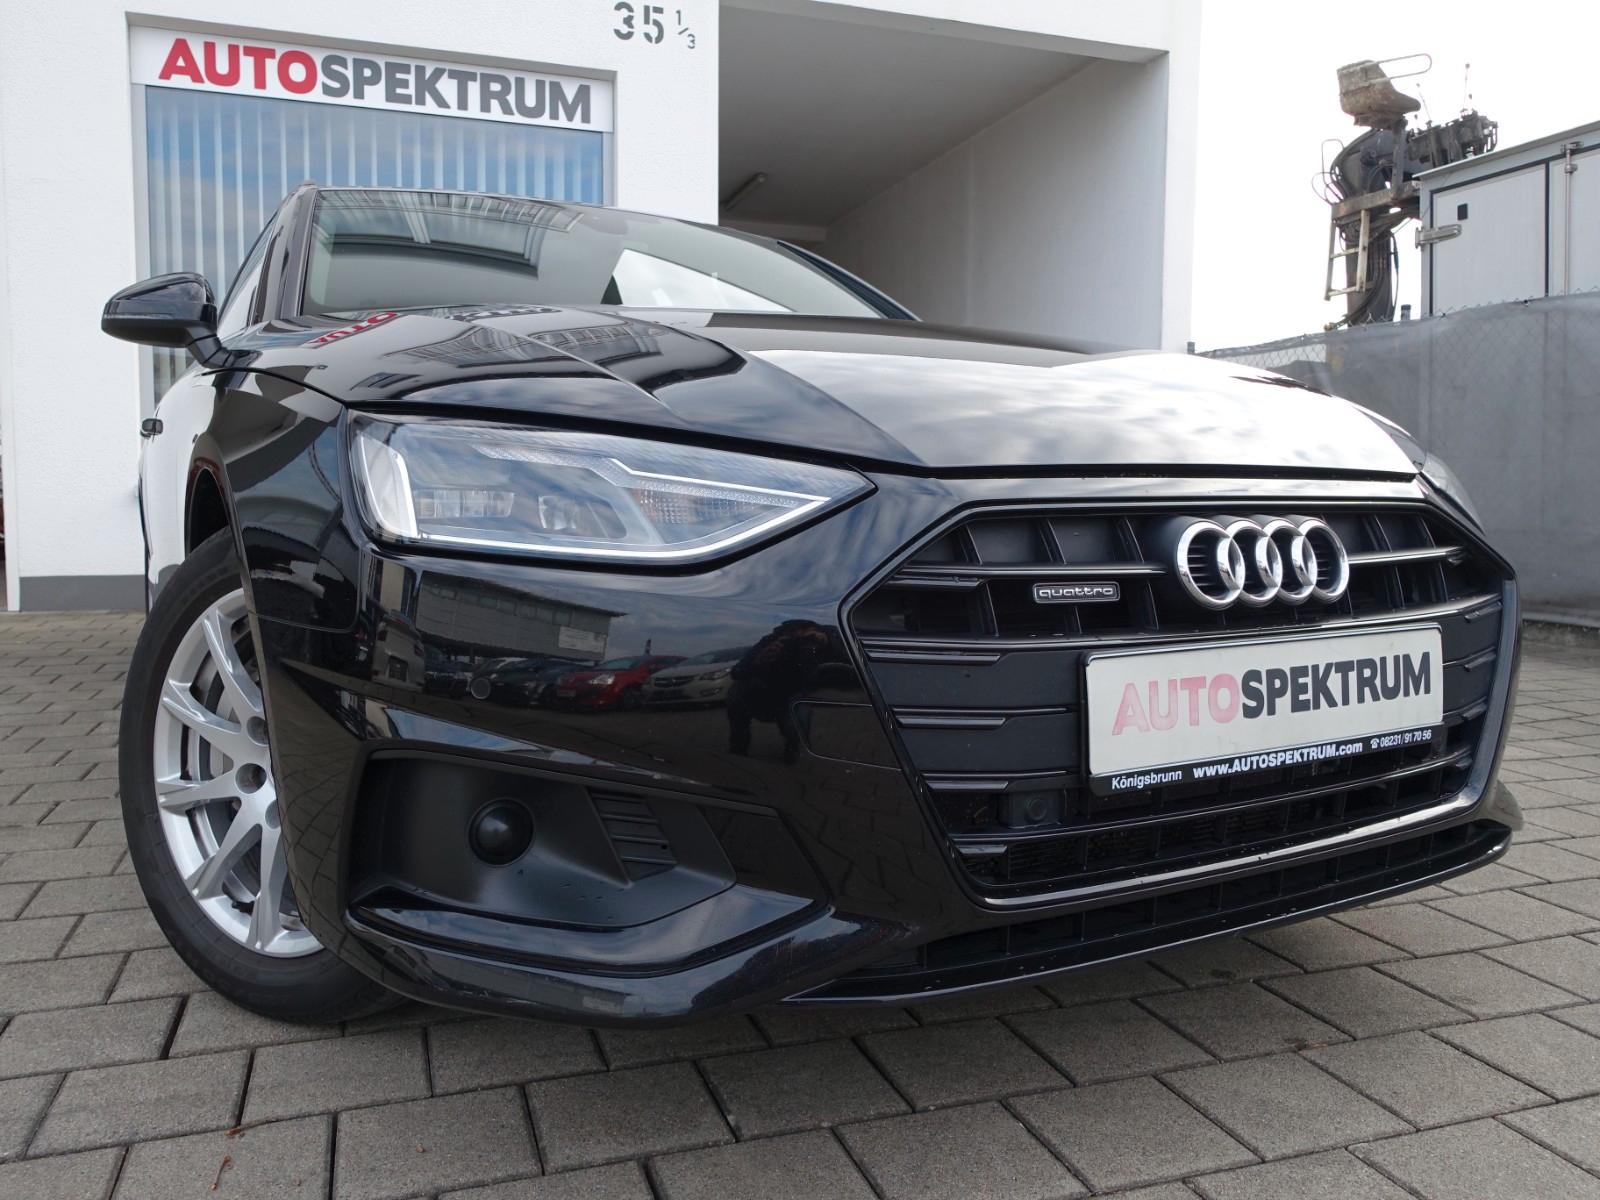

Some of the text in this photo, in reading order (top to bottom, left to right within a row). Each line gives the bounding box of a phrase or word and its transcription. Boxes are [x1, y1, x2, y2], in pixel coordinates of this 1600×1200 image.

[613, 2, 664, 44] 35
[159, 38, 592, 124] AUTOSPEKTRUM
[1039, 587, 1114, 598] quattro
[1112, 651, 1431, 736] AUTOSPEKTRUM
[1111, 769, 1182, 790] Königsbrunn
[1193, 742, 1363, 779] www.AUTOSPEKTRUM.com
